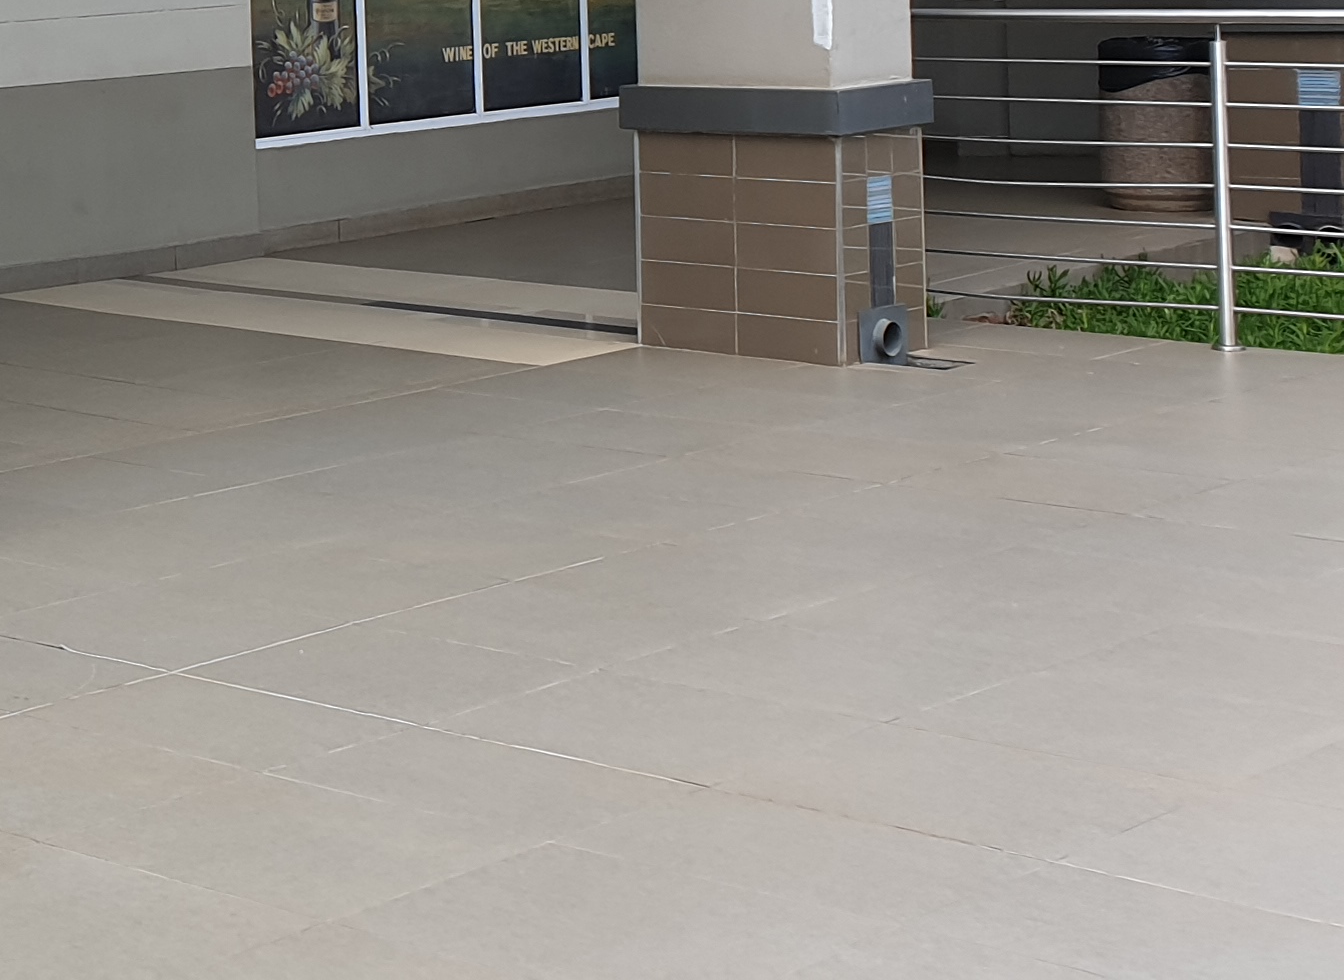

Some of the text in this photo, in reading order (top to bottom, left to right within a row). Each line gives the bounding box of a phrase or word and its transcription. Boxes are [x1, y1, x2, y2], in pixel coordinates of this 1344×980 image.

[442, 33, 616, 63] WINE OF THE WESTERN CAPE
